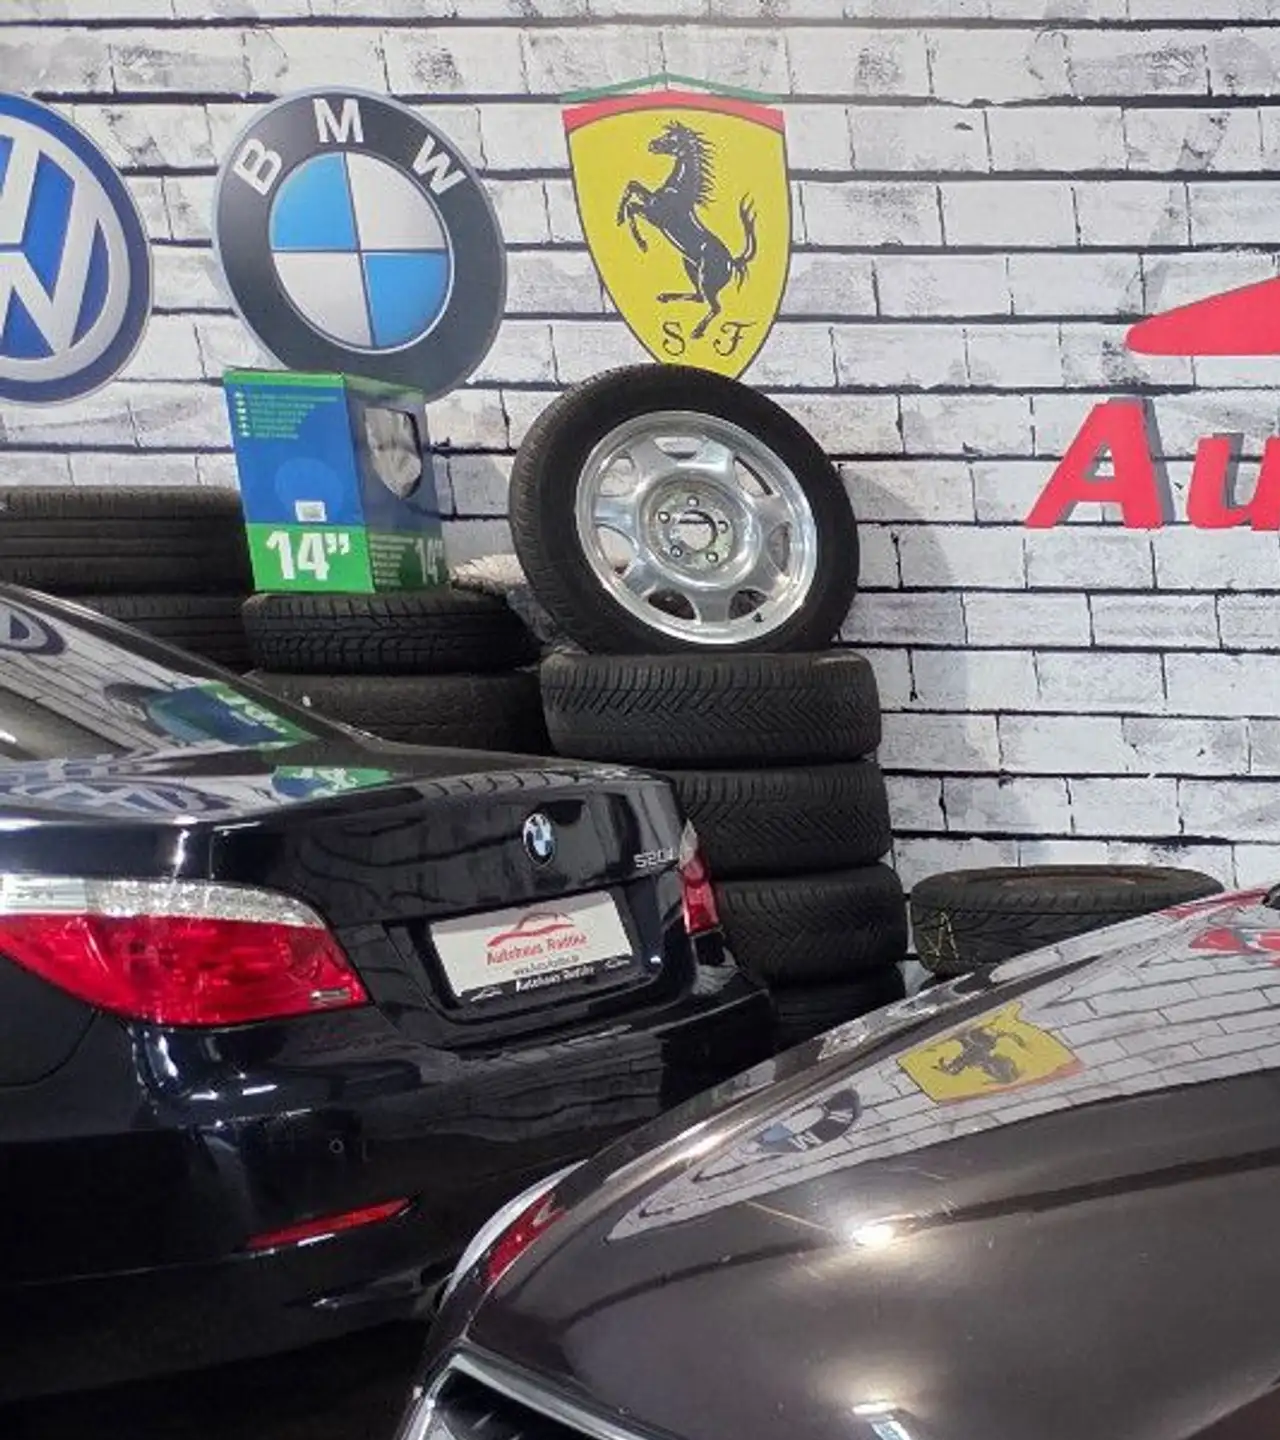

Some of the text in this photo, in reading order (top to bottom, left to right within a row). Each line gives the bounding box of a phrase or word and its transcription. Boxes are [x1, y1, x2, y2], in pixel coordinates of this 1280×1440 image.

[232, 97, 468, 196] BMW
[662, 321, 686, 356] S
[265, 530, 351, 581] 14"
